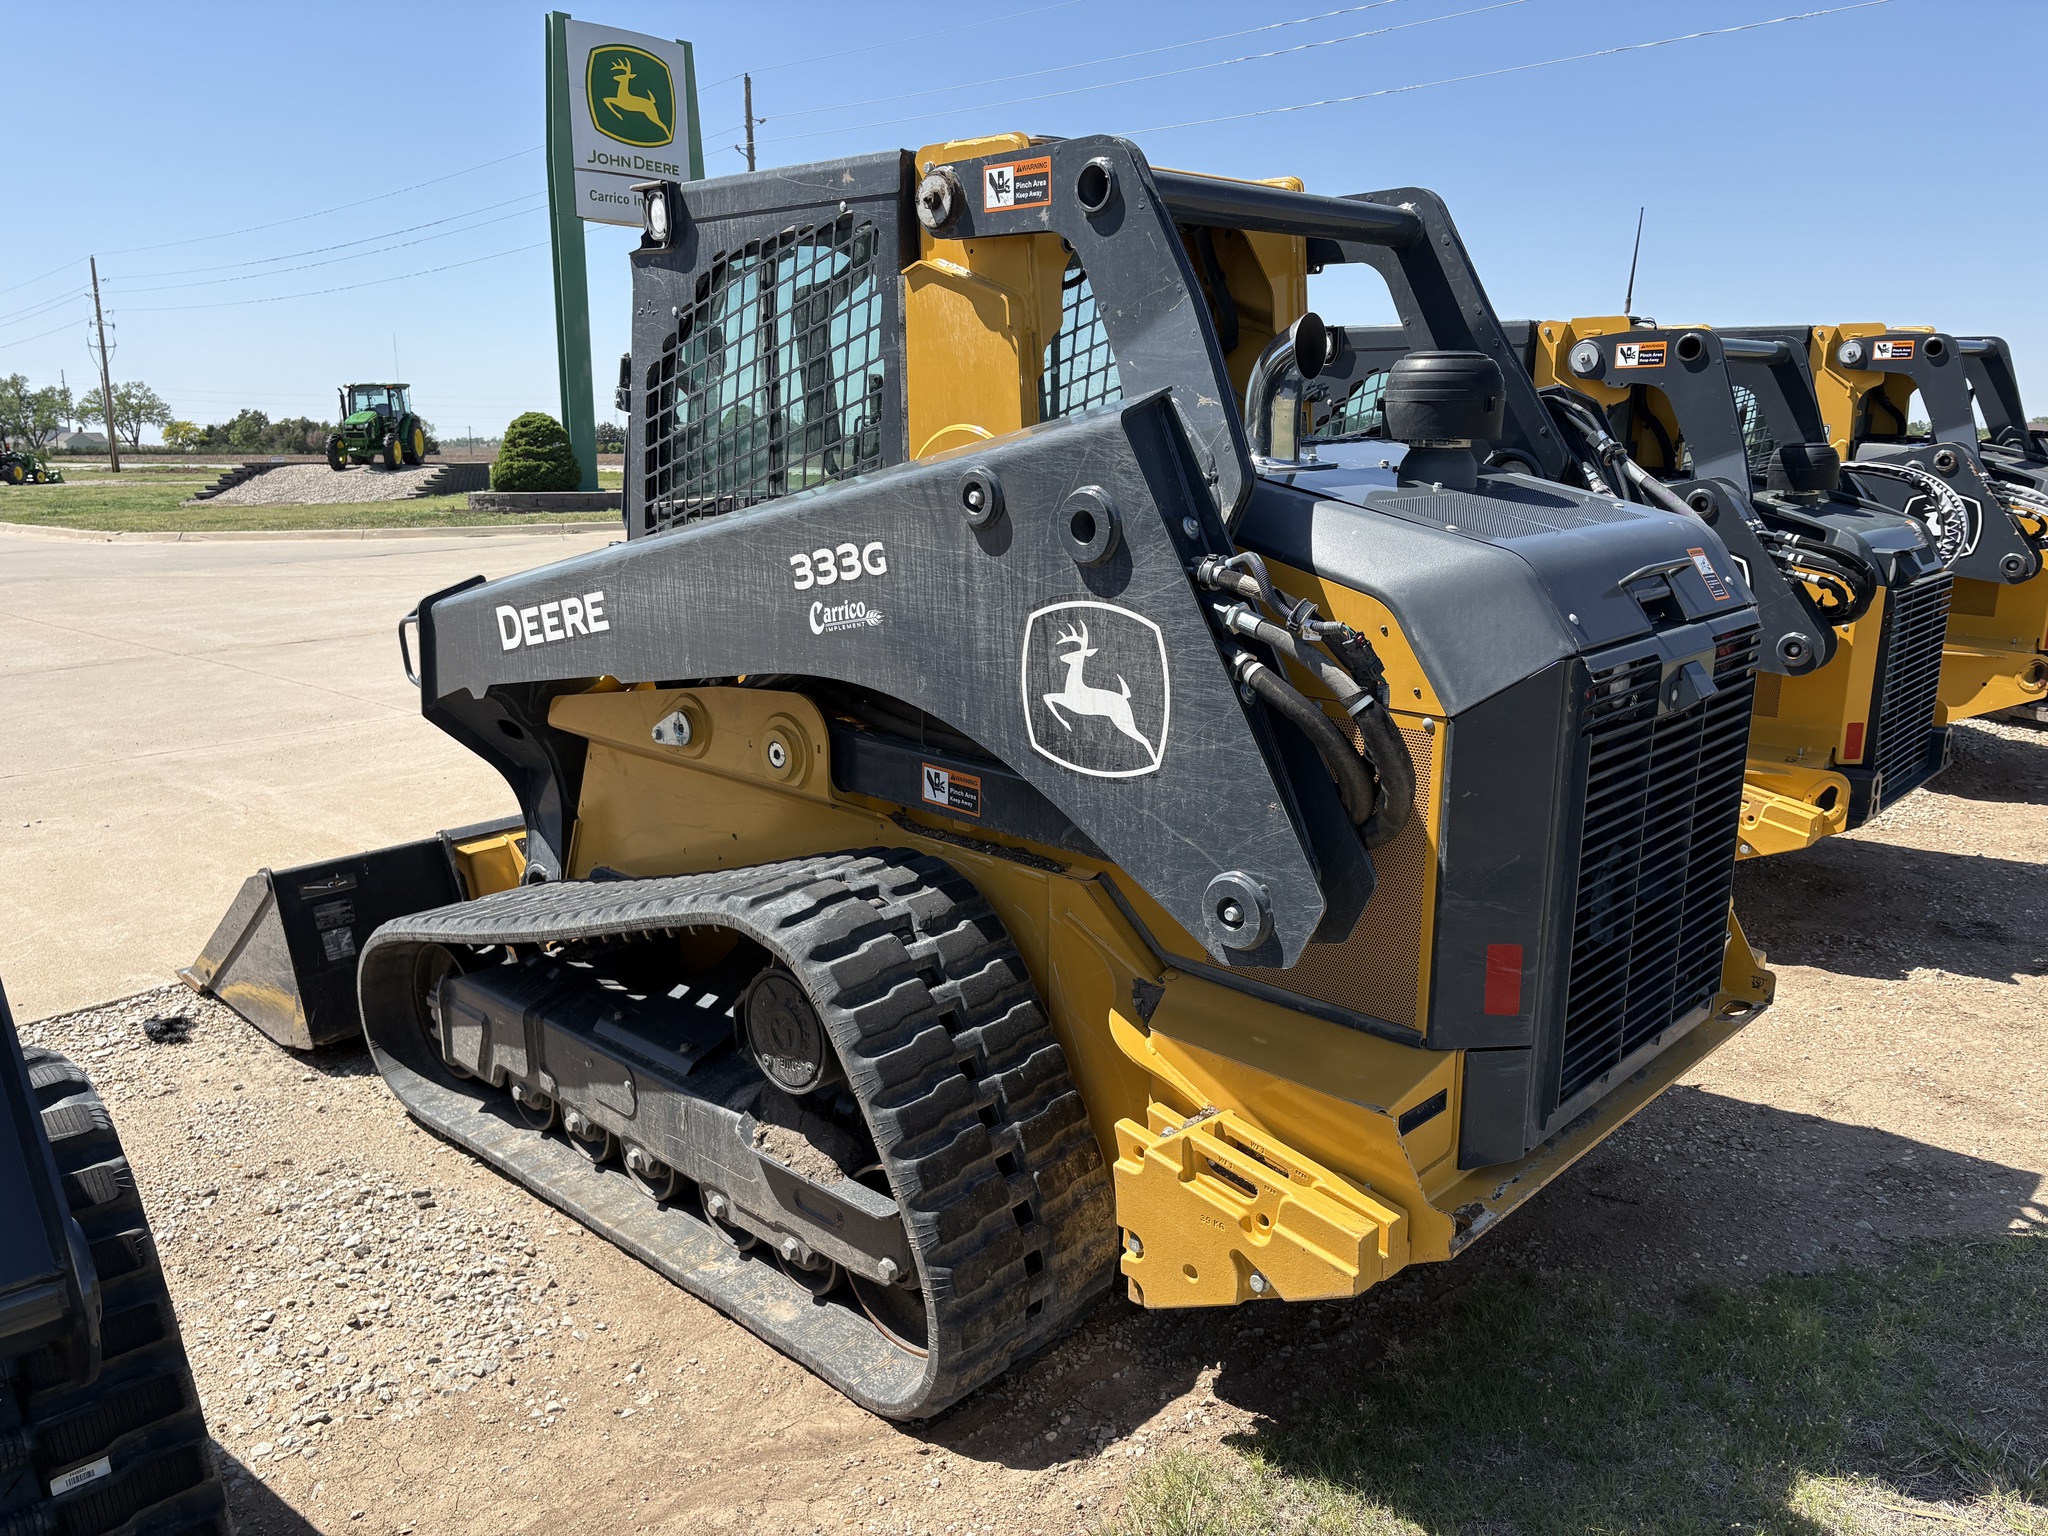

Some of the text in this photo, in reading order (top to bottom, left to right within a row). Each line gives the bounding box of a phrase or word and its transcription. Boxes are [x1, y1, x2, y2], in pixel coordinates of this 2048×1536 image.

[587, 149, 680, 176] JOHN DEERE
[1021, 161, 1048, 172] WARNING
[1015, 179, 1047, 190] Pinch Area
[589, 189, 630, 205] Carrico
[1015, 190, 1043, 200] Keep Away
[789, 541, 888, 590] 333G
[495, 590, 610, 651] DEERE
[809, 599, 866, 635] Carrico
[825, 621, 866, 633] IMPLEMENT
[955, 775, 978, 787] WARNING
[949, 787, 977, 801] Pinch Area
[961, 799, 973, 808] Away
